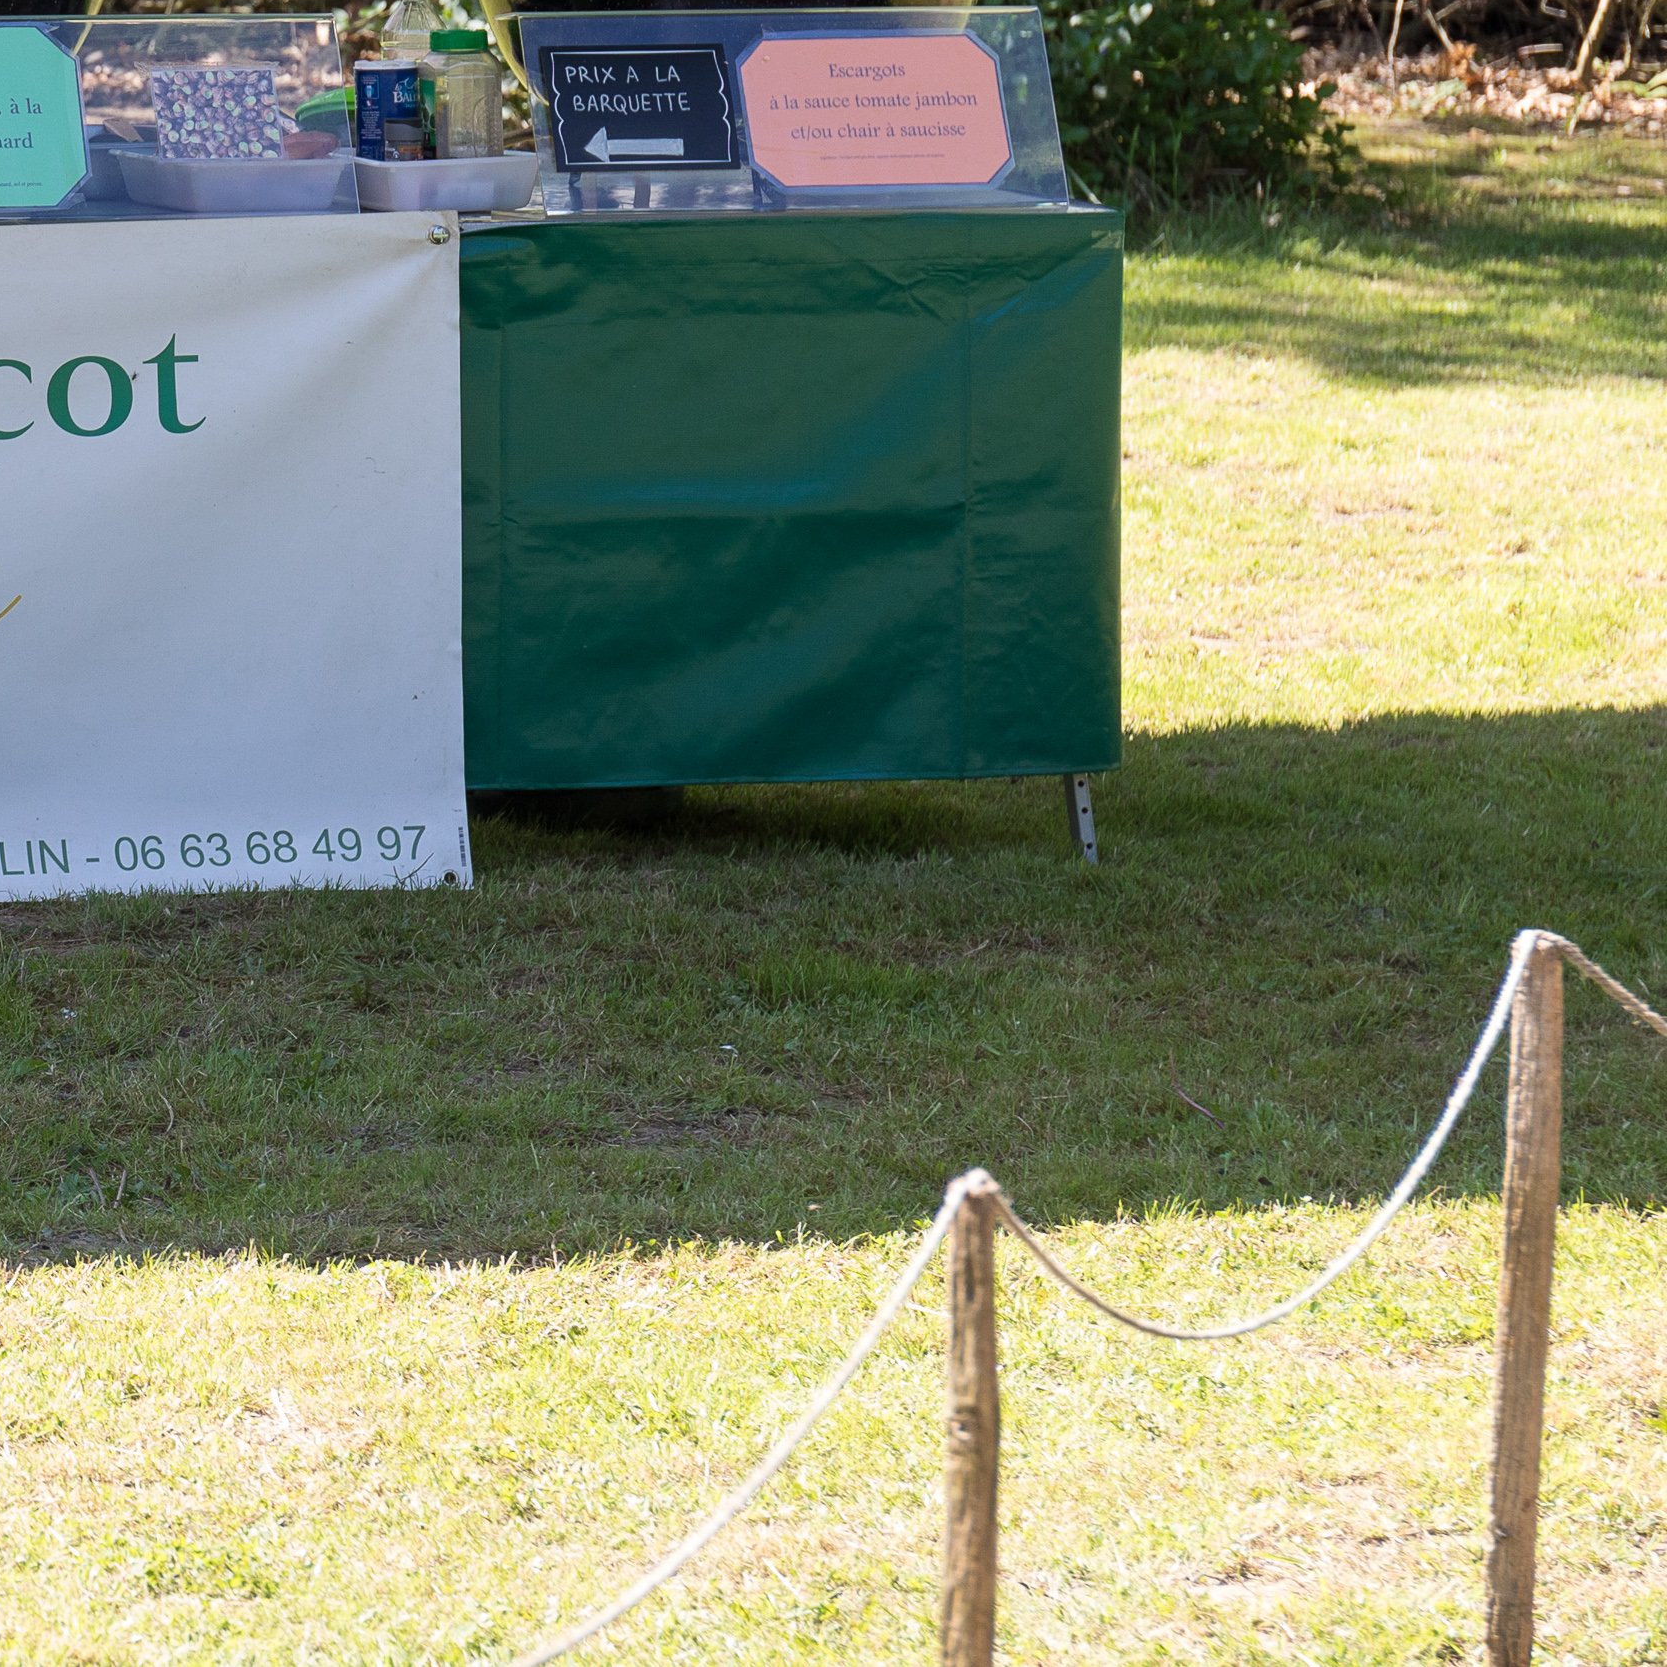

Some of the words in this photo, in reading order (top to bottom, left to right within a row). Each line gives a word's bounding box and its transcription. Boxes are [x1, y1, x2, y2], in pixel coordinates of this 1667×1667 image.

[565, 66, 616, 84] PRIX
[626, 66, 639, 83] A
[655, 65, 680, 82] LA
[829, 63, 906, 81] Escargots
[10, 98, 20, 114] à
[26, 98, 42, 114] la
[573, 92, 690, 115] BARQUETTE
[770, 95, 779, 110] à
[784, 95, 799, 109] la
[804, 96, 850, 109] sauce
[855, 94, 910, 108] tomate
[915, 91, 977, 110] jambon
[791, 126, 832, 141] et/ou
[838, 123, 881, 138] chair
[886, 123, 895, 137] à
[900, 122, 966, 137] saucisse
[113, 836, 165, 871] 06
[179, 833, 232, 868] 63
[245, 830, 298, 865] 68
[311, 828, 364, 862] 49
[377, 825, 427, 861] 97
